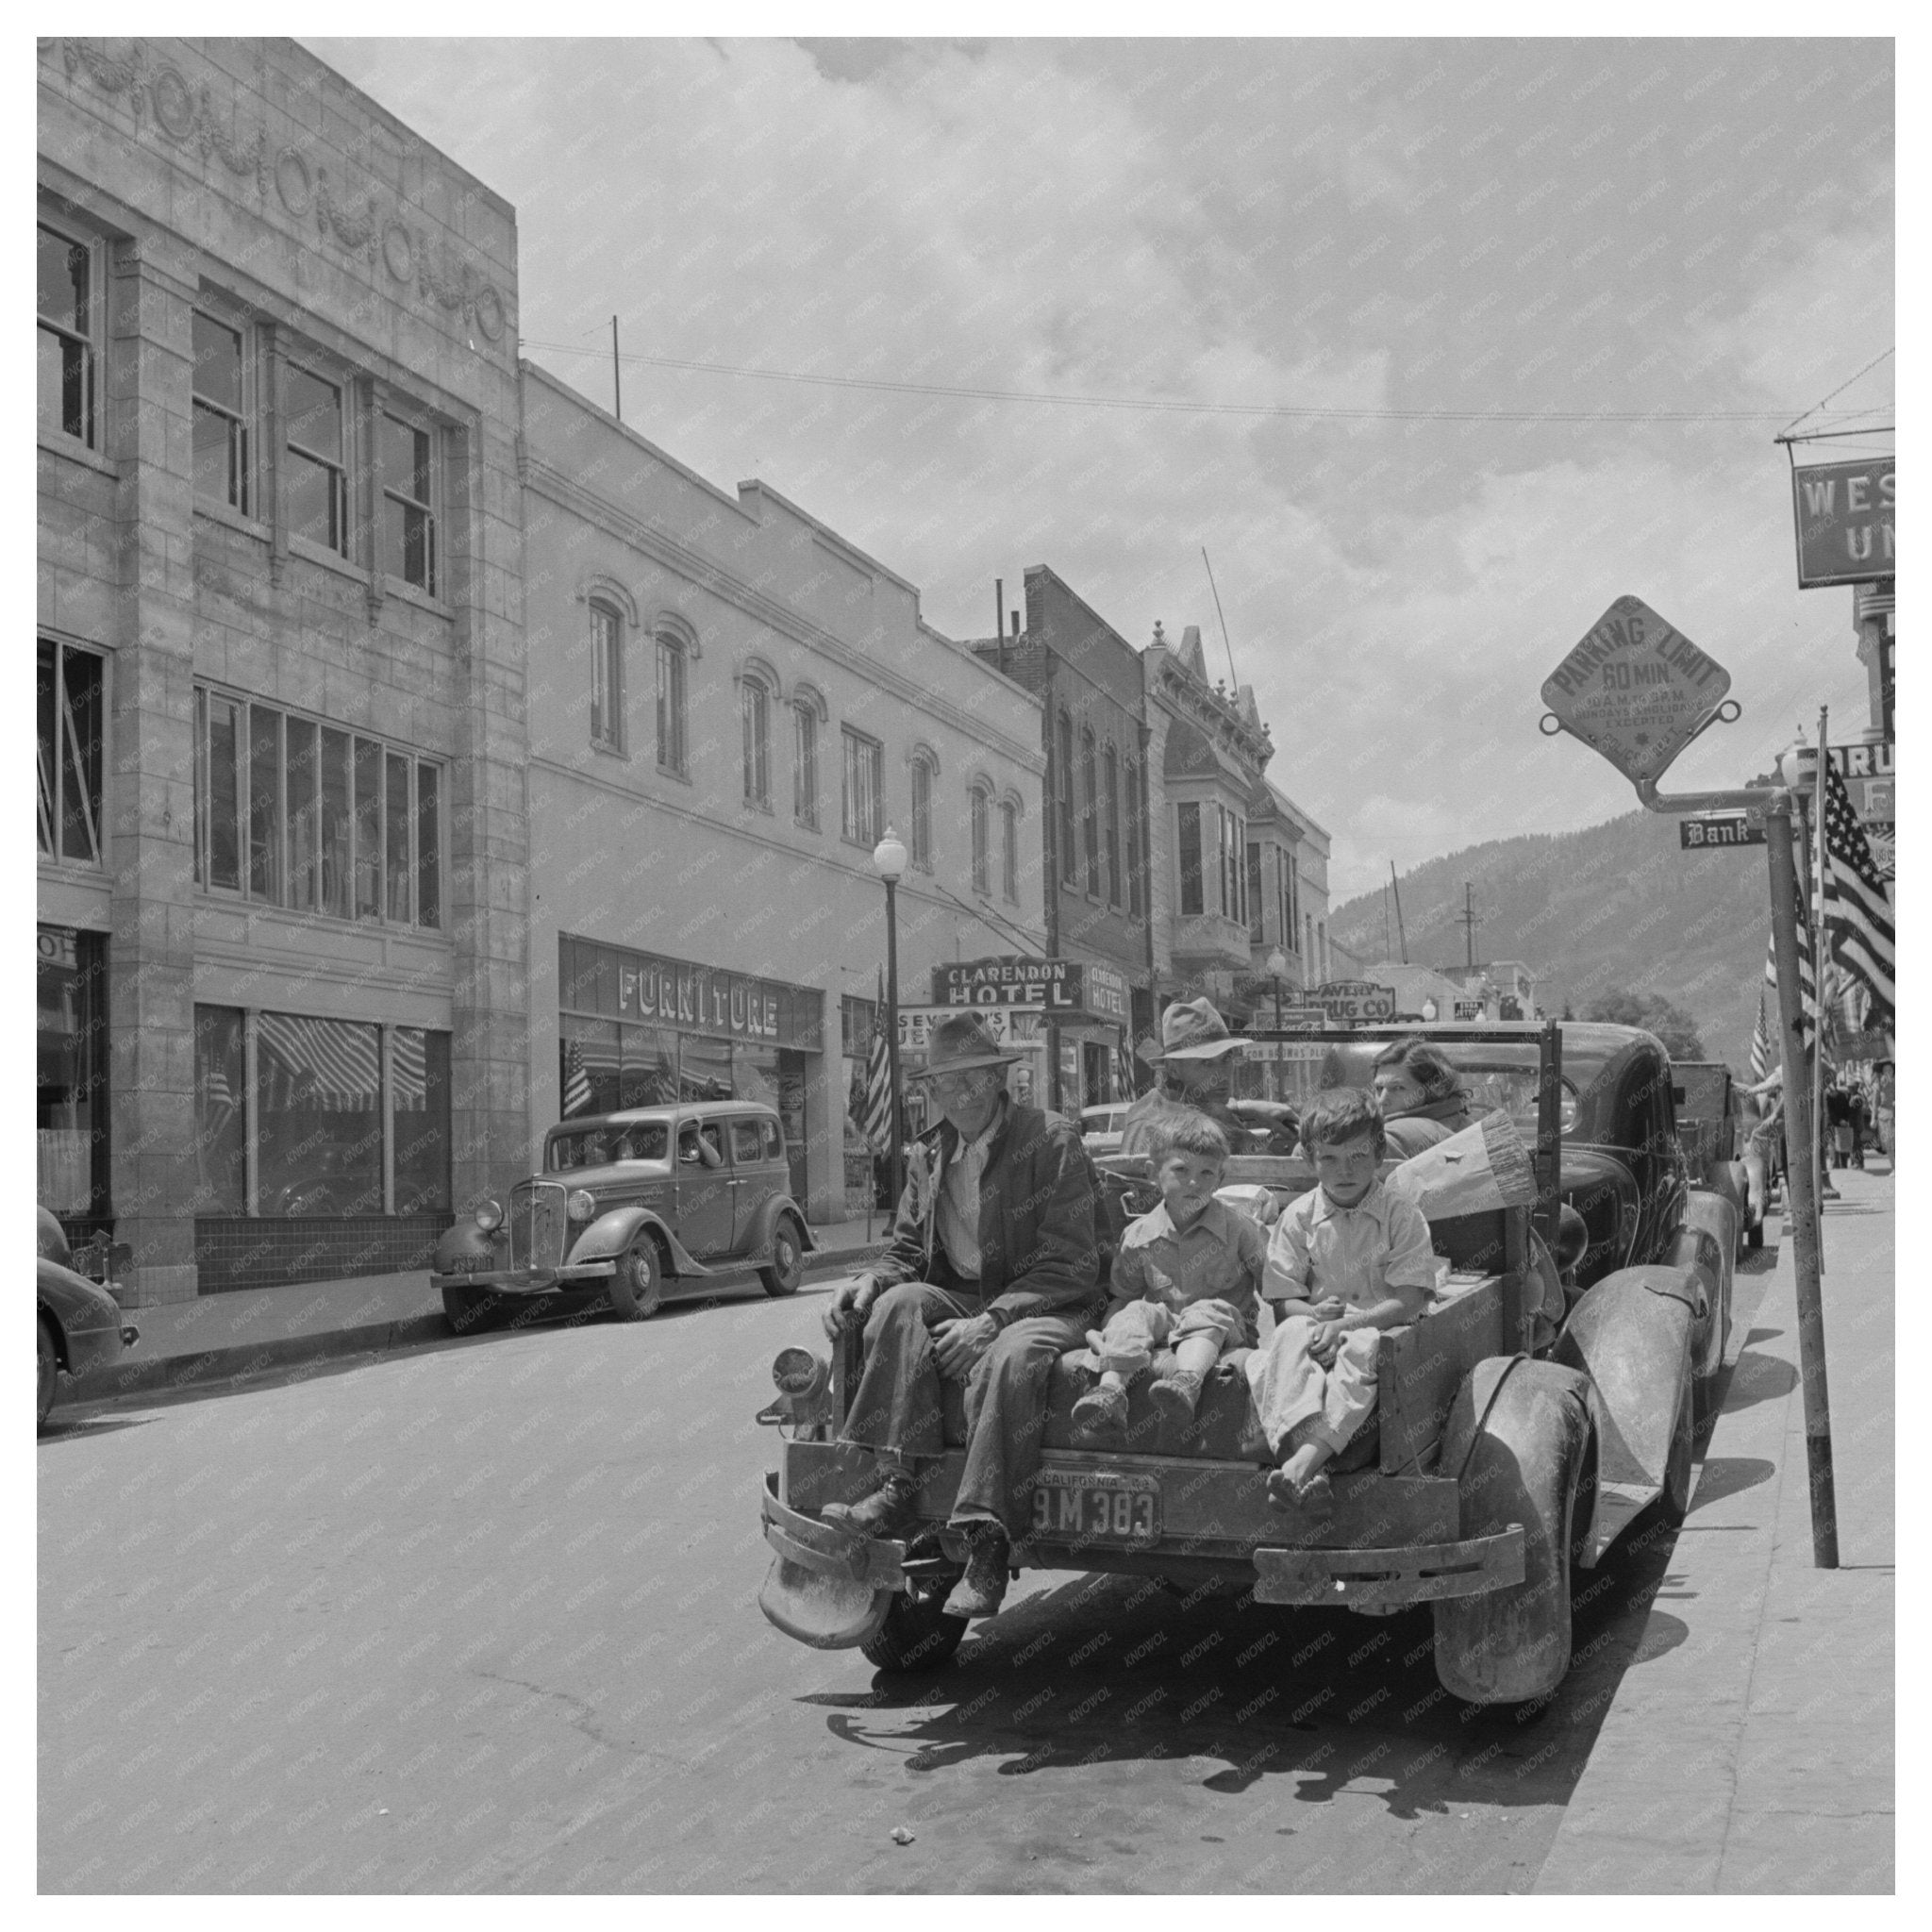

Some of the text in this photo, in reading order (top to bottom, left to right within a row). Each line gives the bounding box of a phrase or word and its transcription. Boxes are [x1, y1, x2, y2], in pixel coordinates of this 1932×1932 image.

[1802, 473, 1895, 518] WES
[1552, 617, 1721, 697] PARKING LIMIT
[1602, 662, 1632, 691] 60
[1606, 715, 1674, 728] EXCEPTED
[1688, 820, 1750, 846] Bank
[947, 963, 1066, 983] CLARENDON
[1091, 967, 1123, 990] CLARENDON
[619, 964, 778, 1037] FURNITURE
[949, 982, 1073, 1007] HOTEL
[1092, 985, 1126, 1014] HOTEL
[1363, 999, 1390, 1017] CO
[1043, 1474, 1118, 1488] CALIFORNIA
